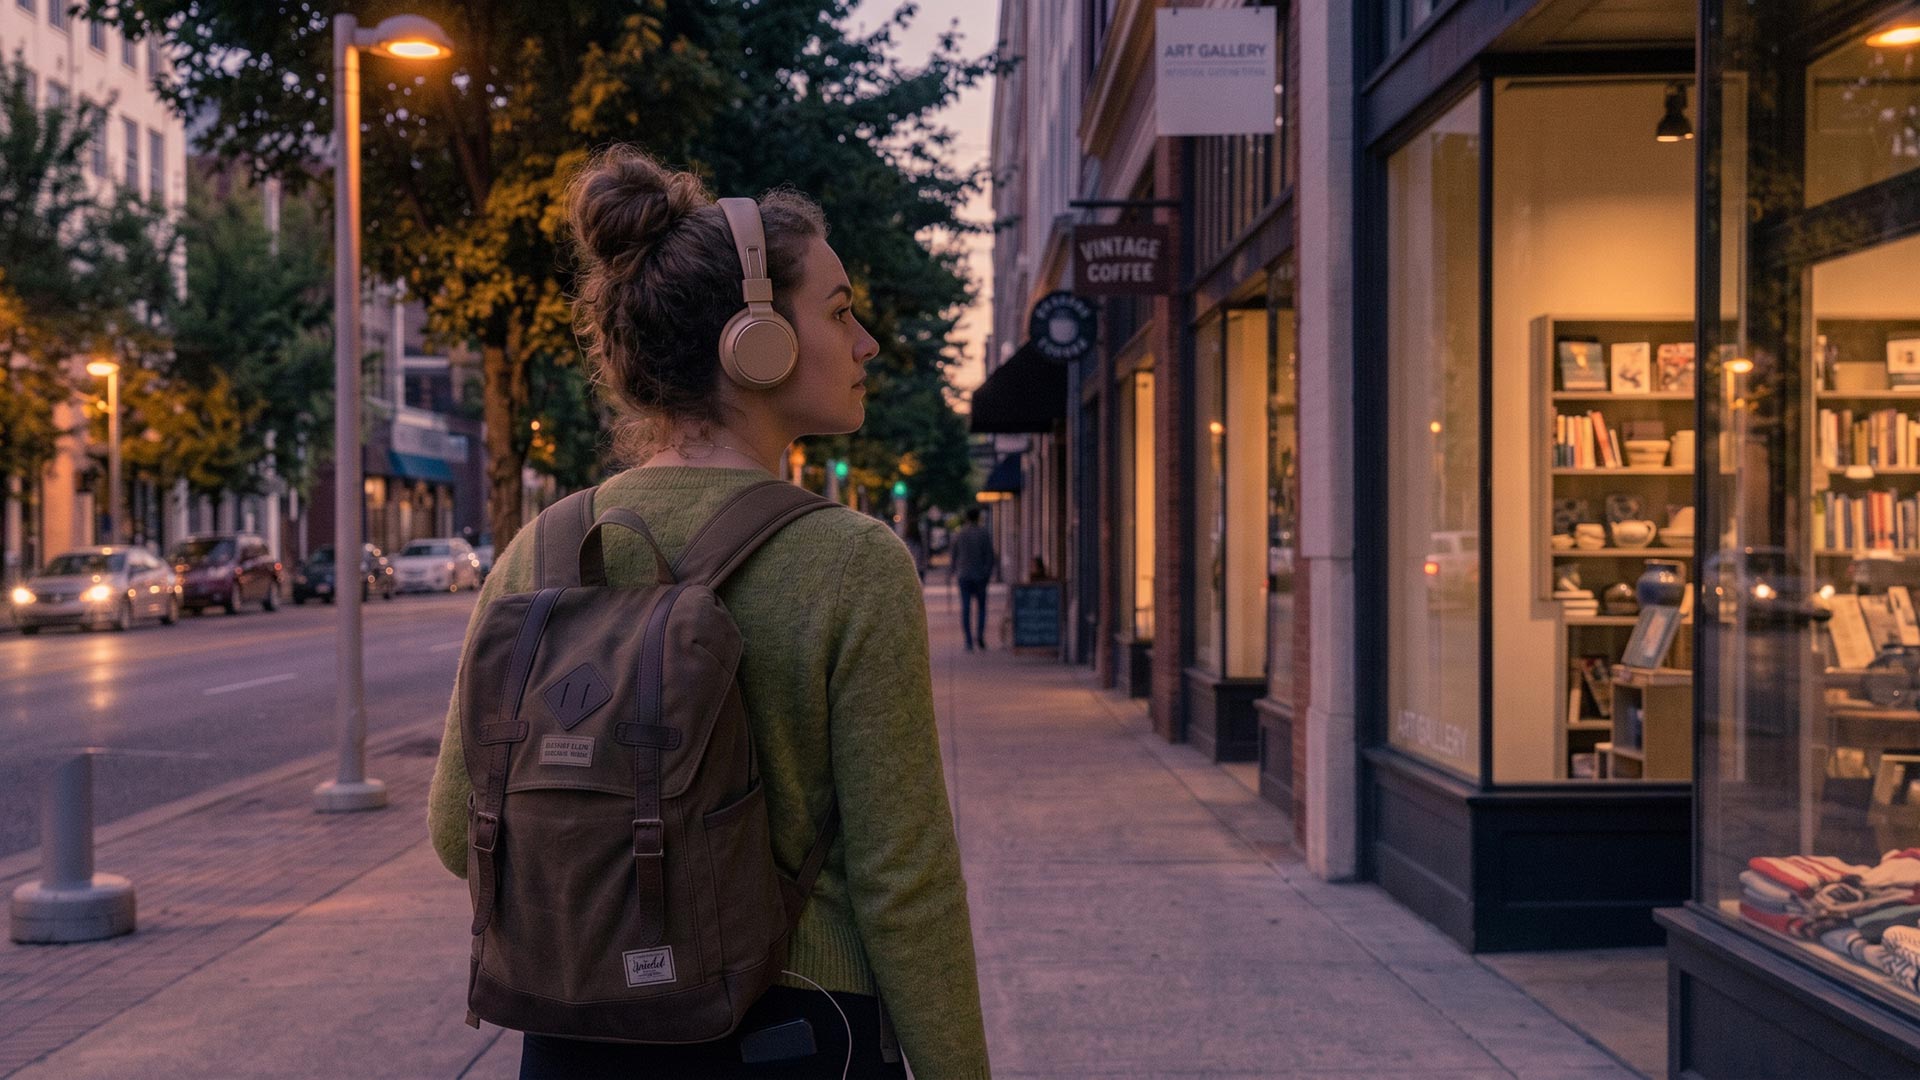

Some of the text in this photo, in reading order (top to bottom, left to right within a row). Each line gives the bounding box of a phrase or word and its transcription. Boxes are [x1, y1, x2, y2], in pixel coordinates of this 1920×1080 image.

[1164, 43, 1266, 58] ART GALLERY
[1080, 236, 1161, 262] VINTAGE
[1087, 262, 1153, 282] COFFEE
